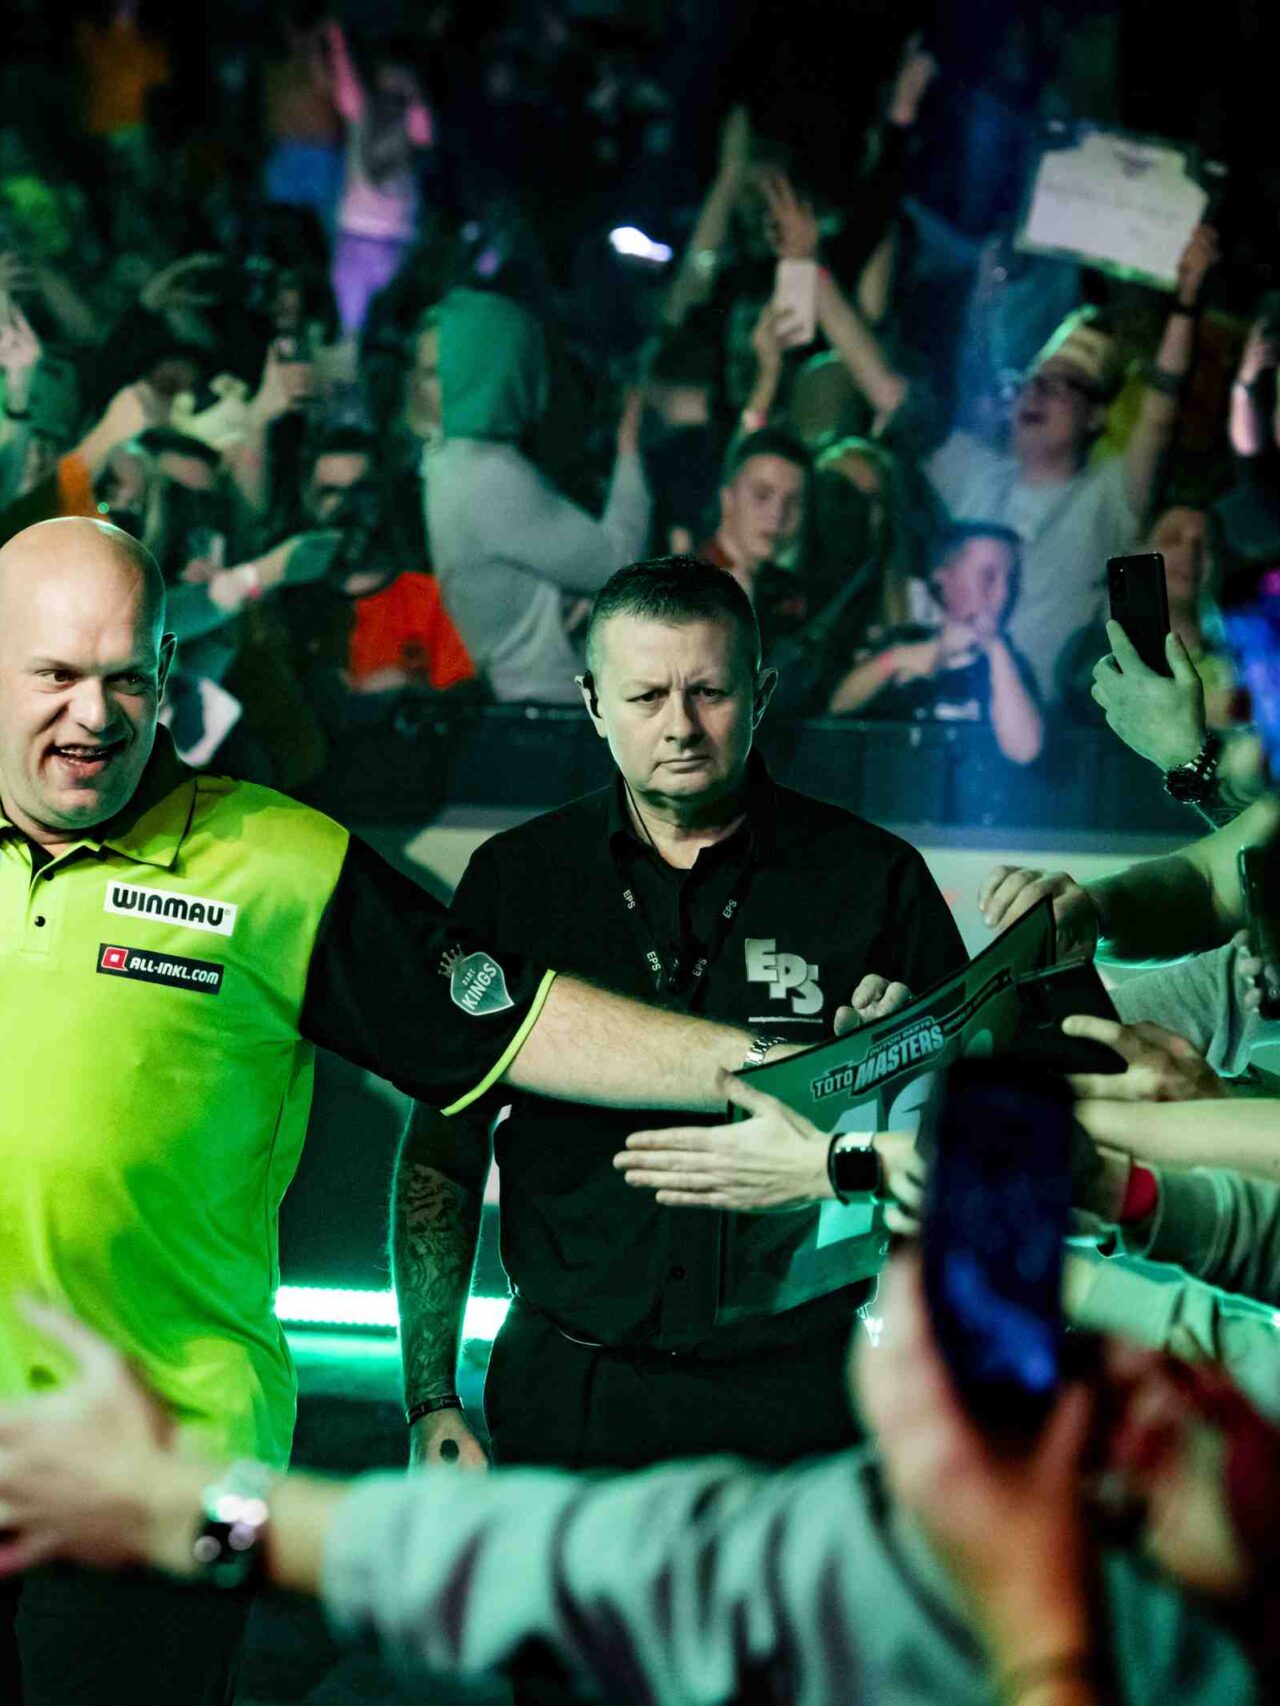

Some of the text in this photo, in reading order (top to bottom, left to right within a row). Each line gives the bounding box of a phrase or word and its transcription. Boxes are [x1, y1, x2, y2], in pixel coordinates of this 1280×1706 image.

[112, 887, 224, 926] WINMAU
[623, 889, 635, 909] EPS
[722, 899, 737, 919] EPS
[646, 951, 661, 971] EPS
[692, 957, 707, 977] EPS
[462, 962, 497, 1010] KINGS
[745, 938, 824, 1014] EPS
[814, 1024, 945, 1098] TOTO MASTERS
